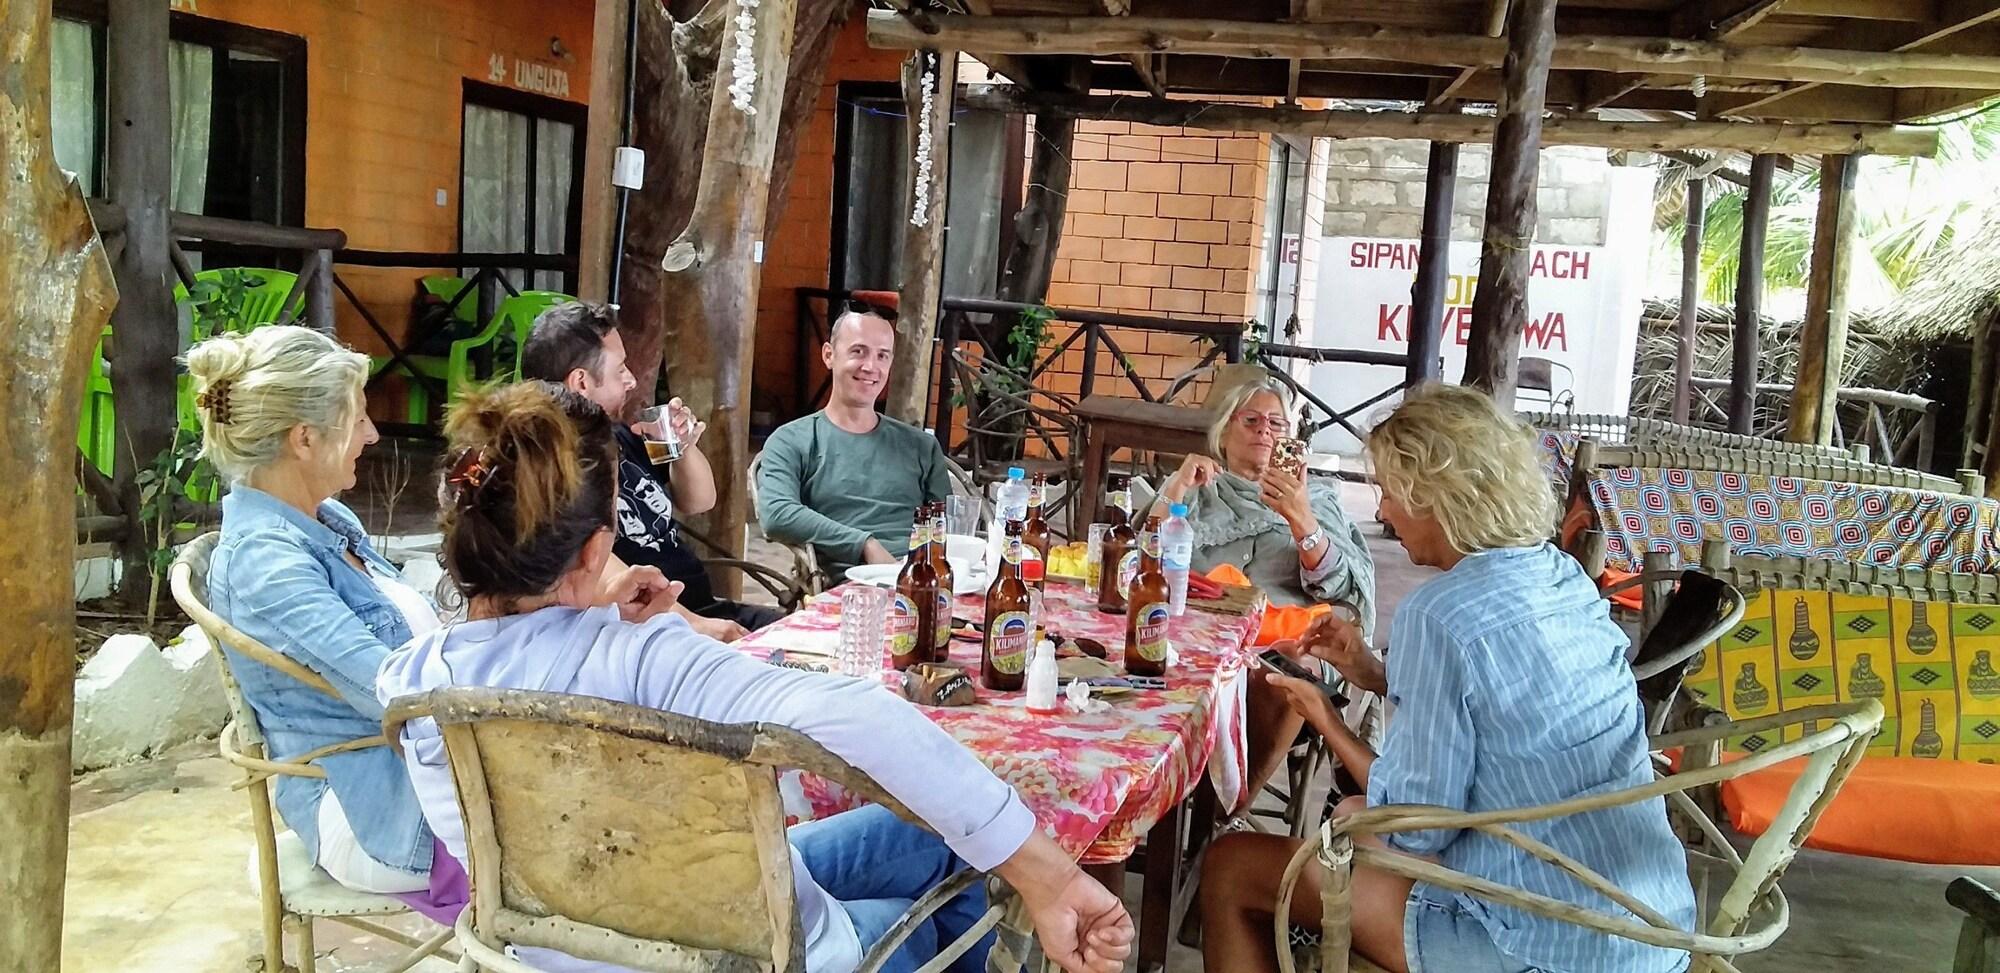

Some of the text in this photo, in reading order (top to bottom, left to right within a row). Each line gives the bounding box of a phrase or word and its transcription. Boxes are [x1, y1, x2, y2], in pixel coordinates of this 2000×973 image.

[515, 59, 569, 98] UNGUJA
[1350, 242, 1591, 280] SIPAN ACH
